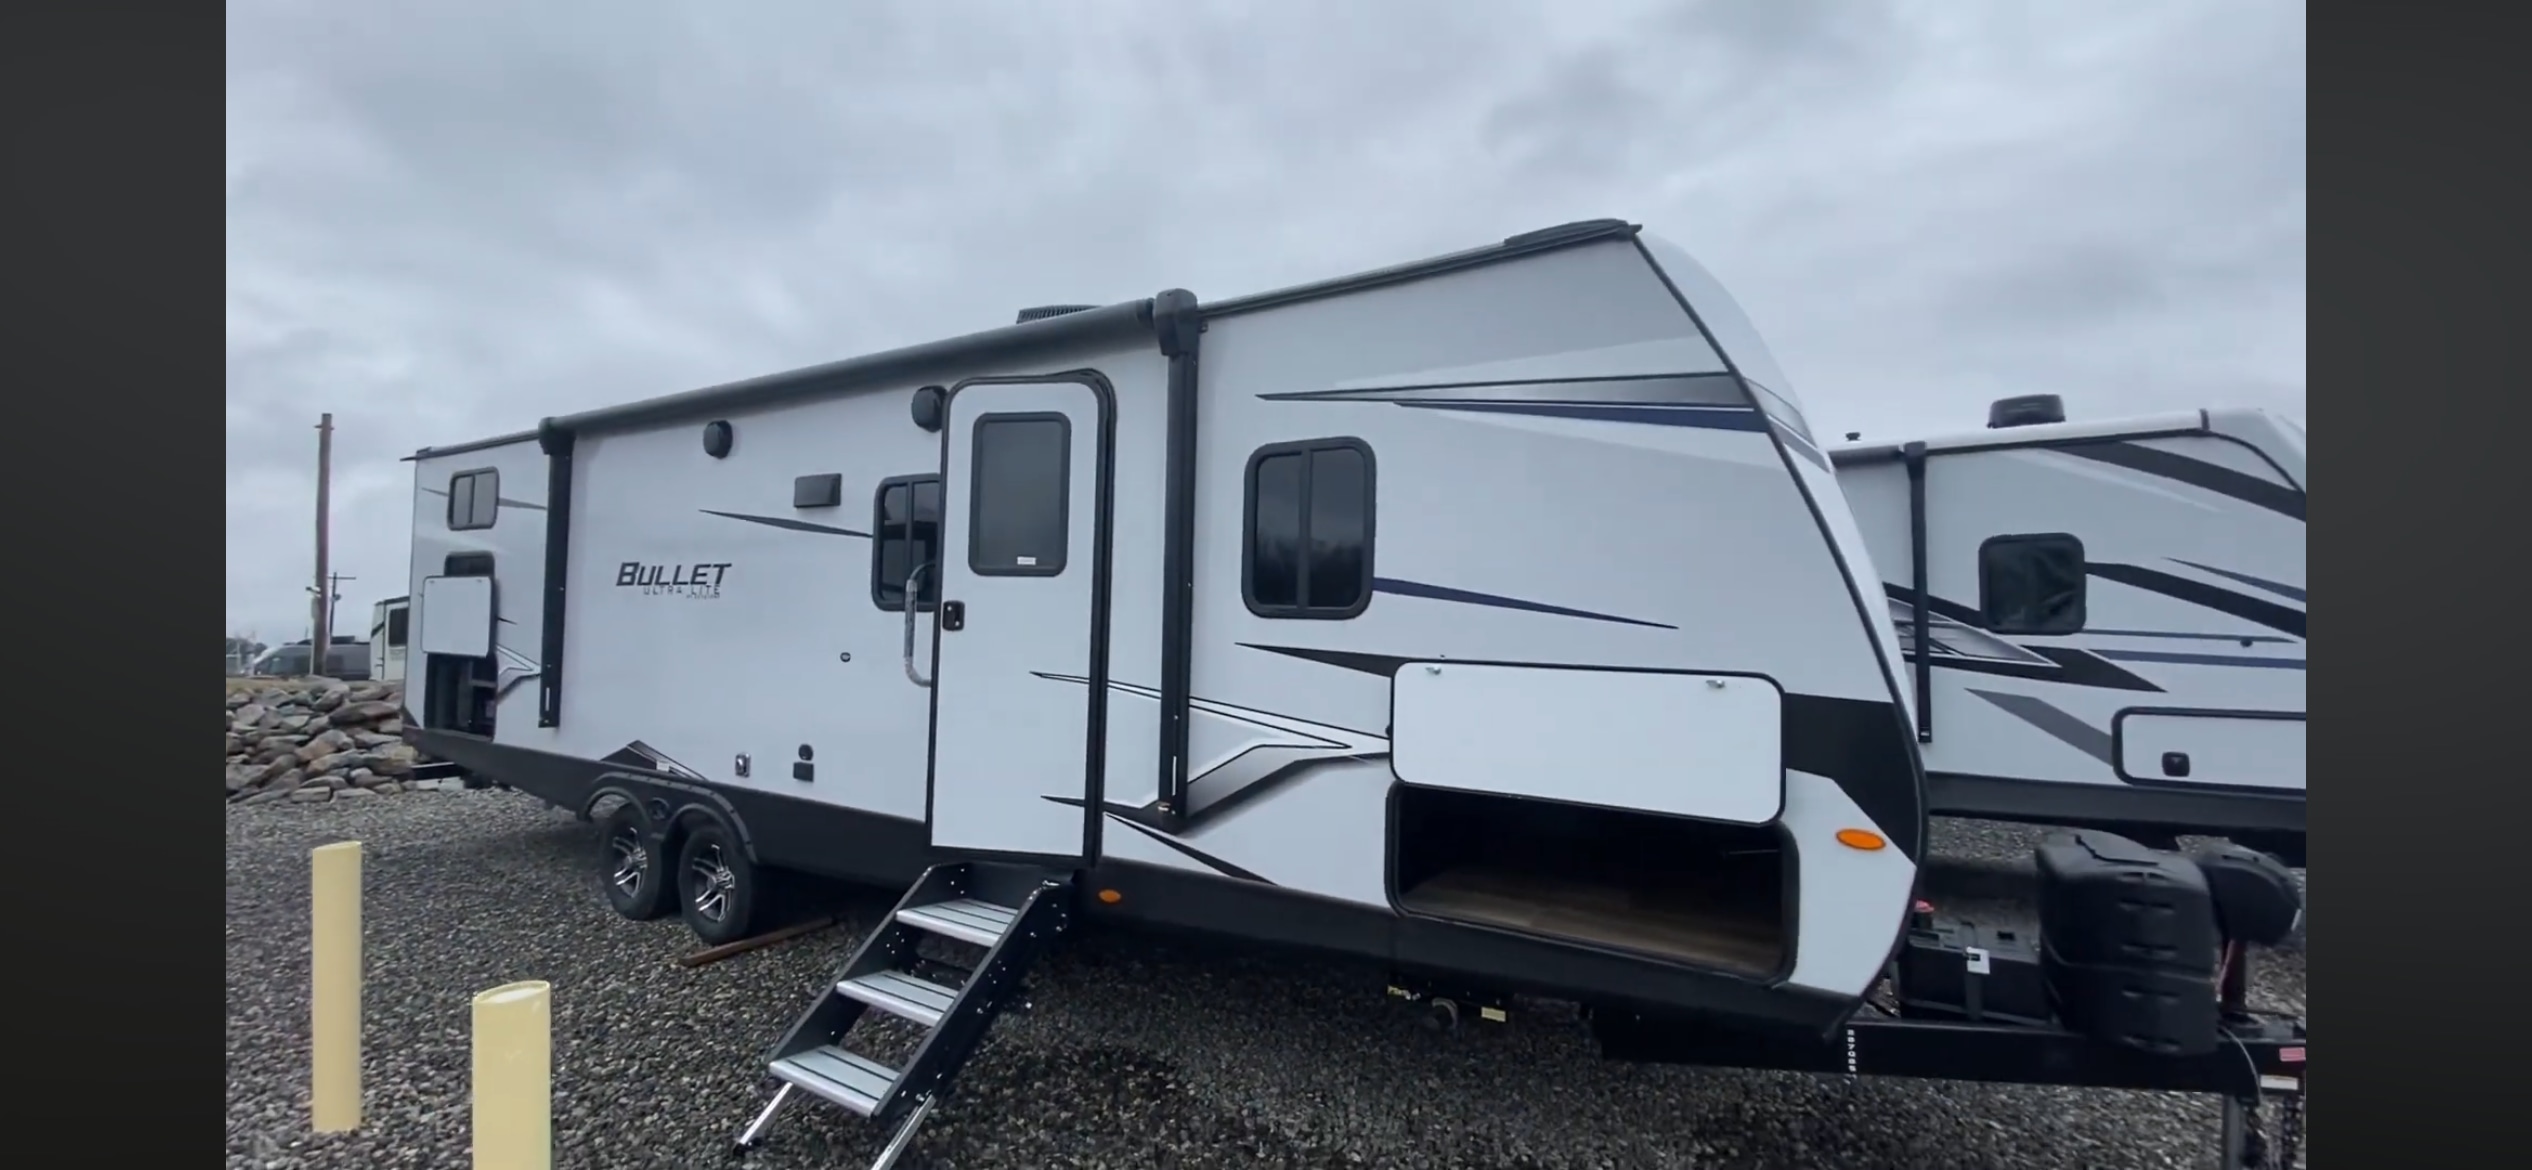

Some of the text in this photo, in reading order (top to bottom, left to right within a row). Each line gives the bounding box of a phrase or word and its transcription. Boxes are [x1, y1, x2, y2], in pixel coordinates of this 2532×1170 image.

[616, 562, 732, 586] BULLET
[643, 584, 720, 595] ULTRA LITE
